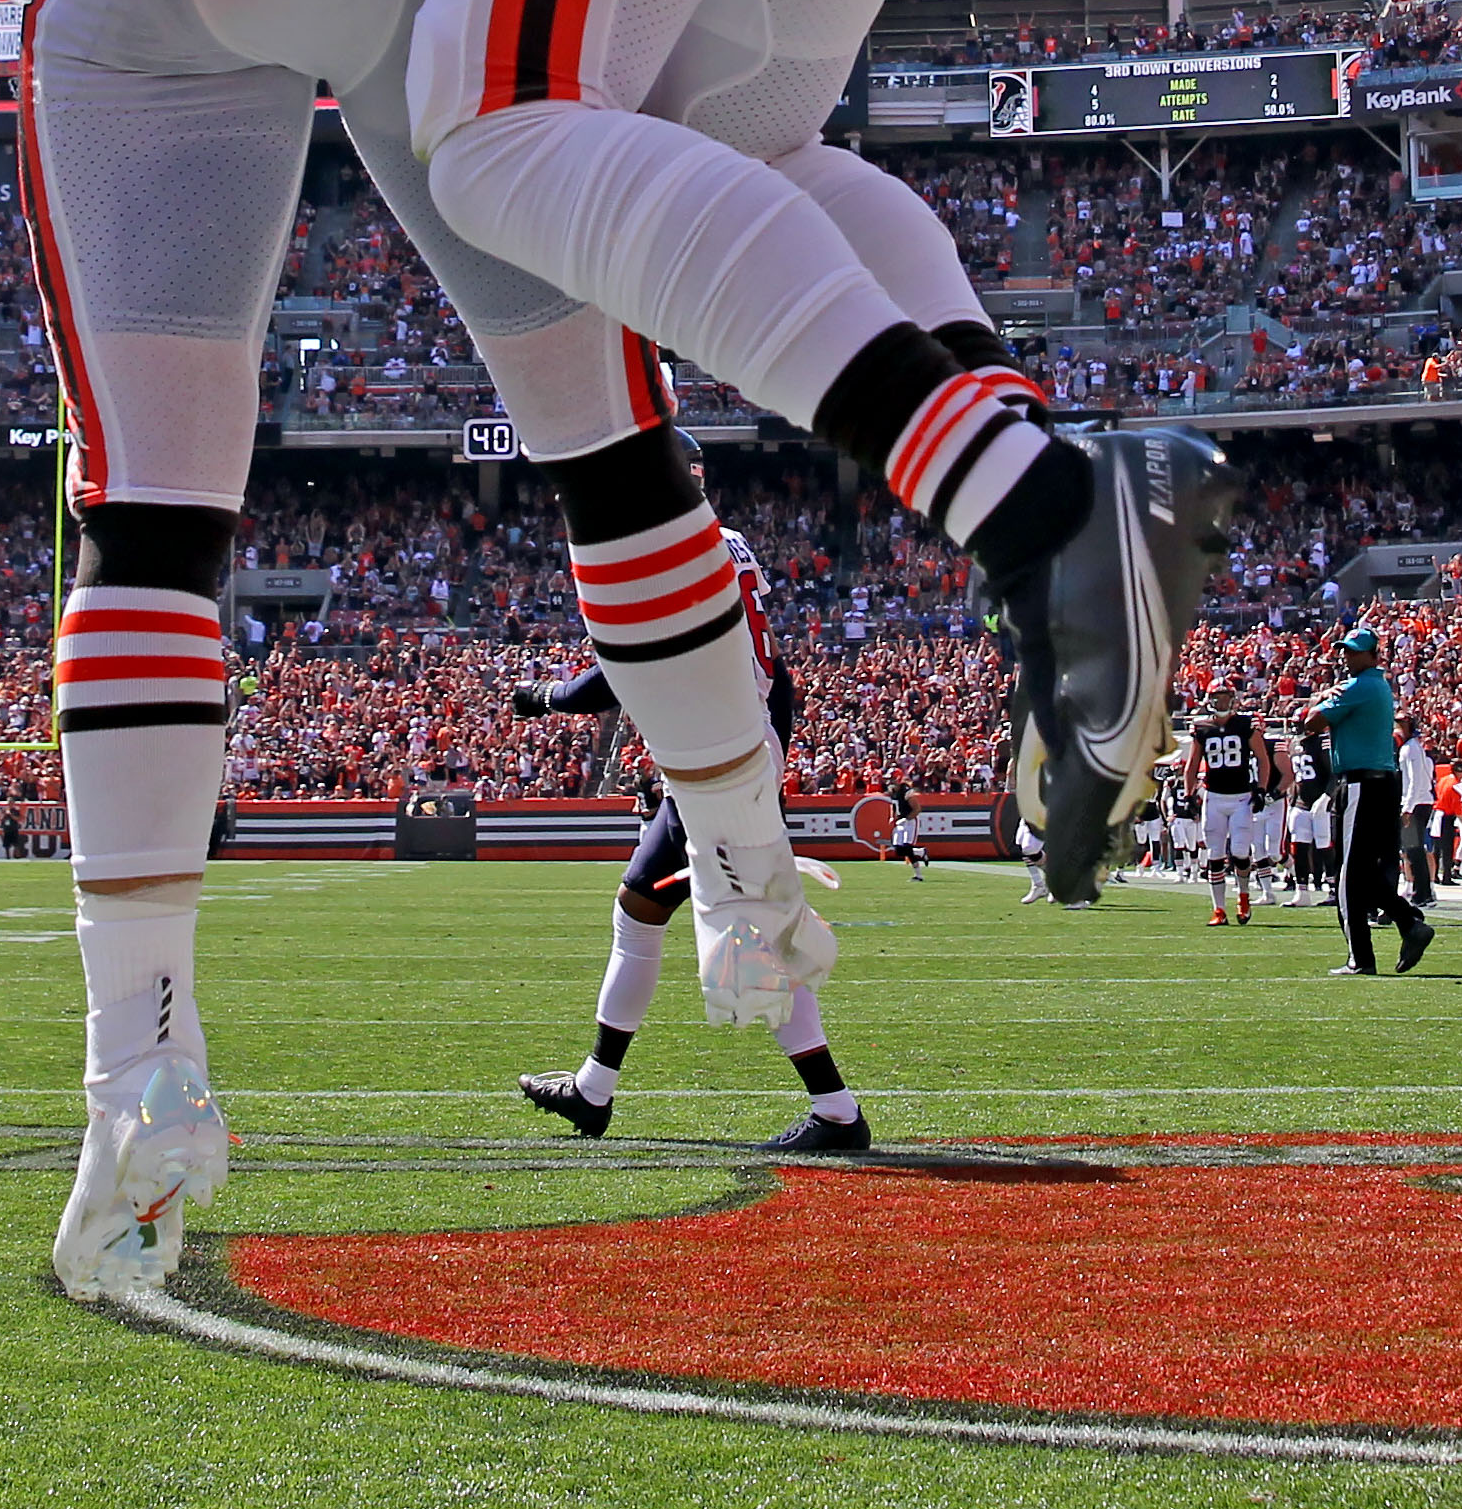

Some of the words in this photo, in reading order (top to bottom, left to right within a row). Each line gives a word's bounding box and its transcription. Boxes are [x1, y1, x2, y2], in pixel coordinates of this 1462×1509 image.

[1105, 63, 1130, 78] 3RD
[1133, 62, 1170, 76] DOWN
[1173, 57, 1262, 75] CONVERSIONS
[1090, 84, 1098, 97] 4
[1170, 78, 1198, 91] MADE
[1270, 73, 1278, 86] 2
[1091, 99, 1099, 111] 5
[1160, 92, 1207, 107] ATTEMPTS
[1270, 87, 1278, 100] 4
[1365, 85, 1452, 111] KeyBank
[1172, 108, 1196, 122] RATE
[1264, 103, 1295, 117] 50.0%
[9, 429, 42, 451] Key
[472, 426, 512, 454] 40
[1205, 735, 1242, 769] 88
